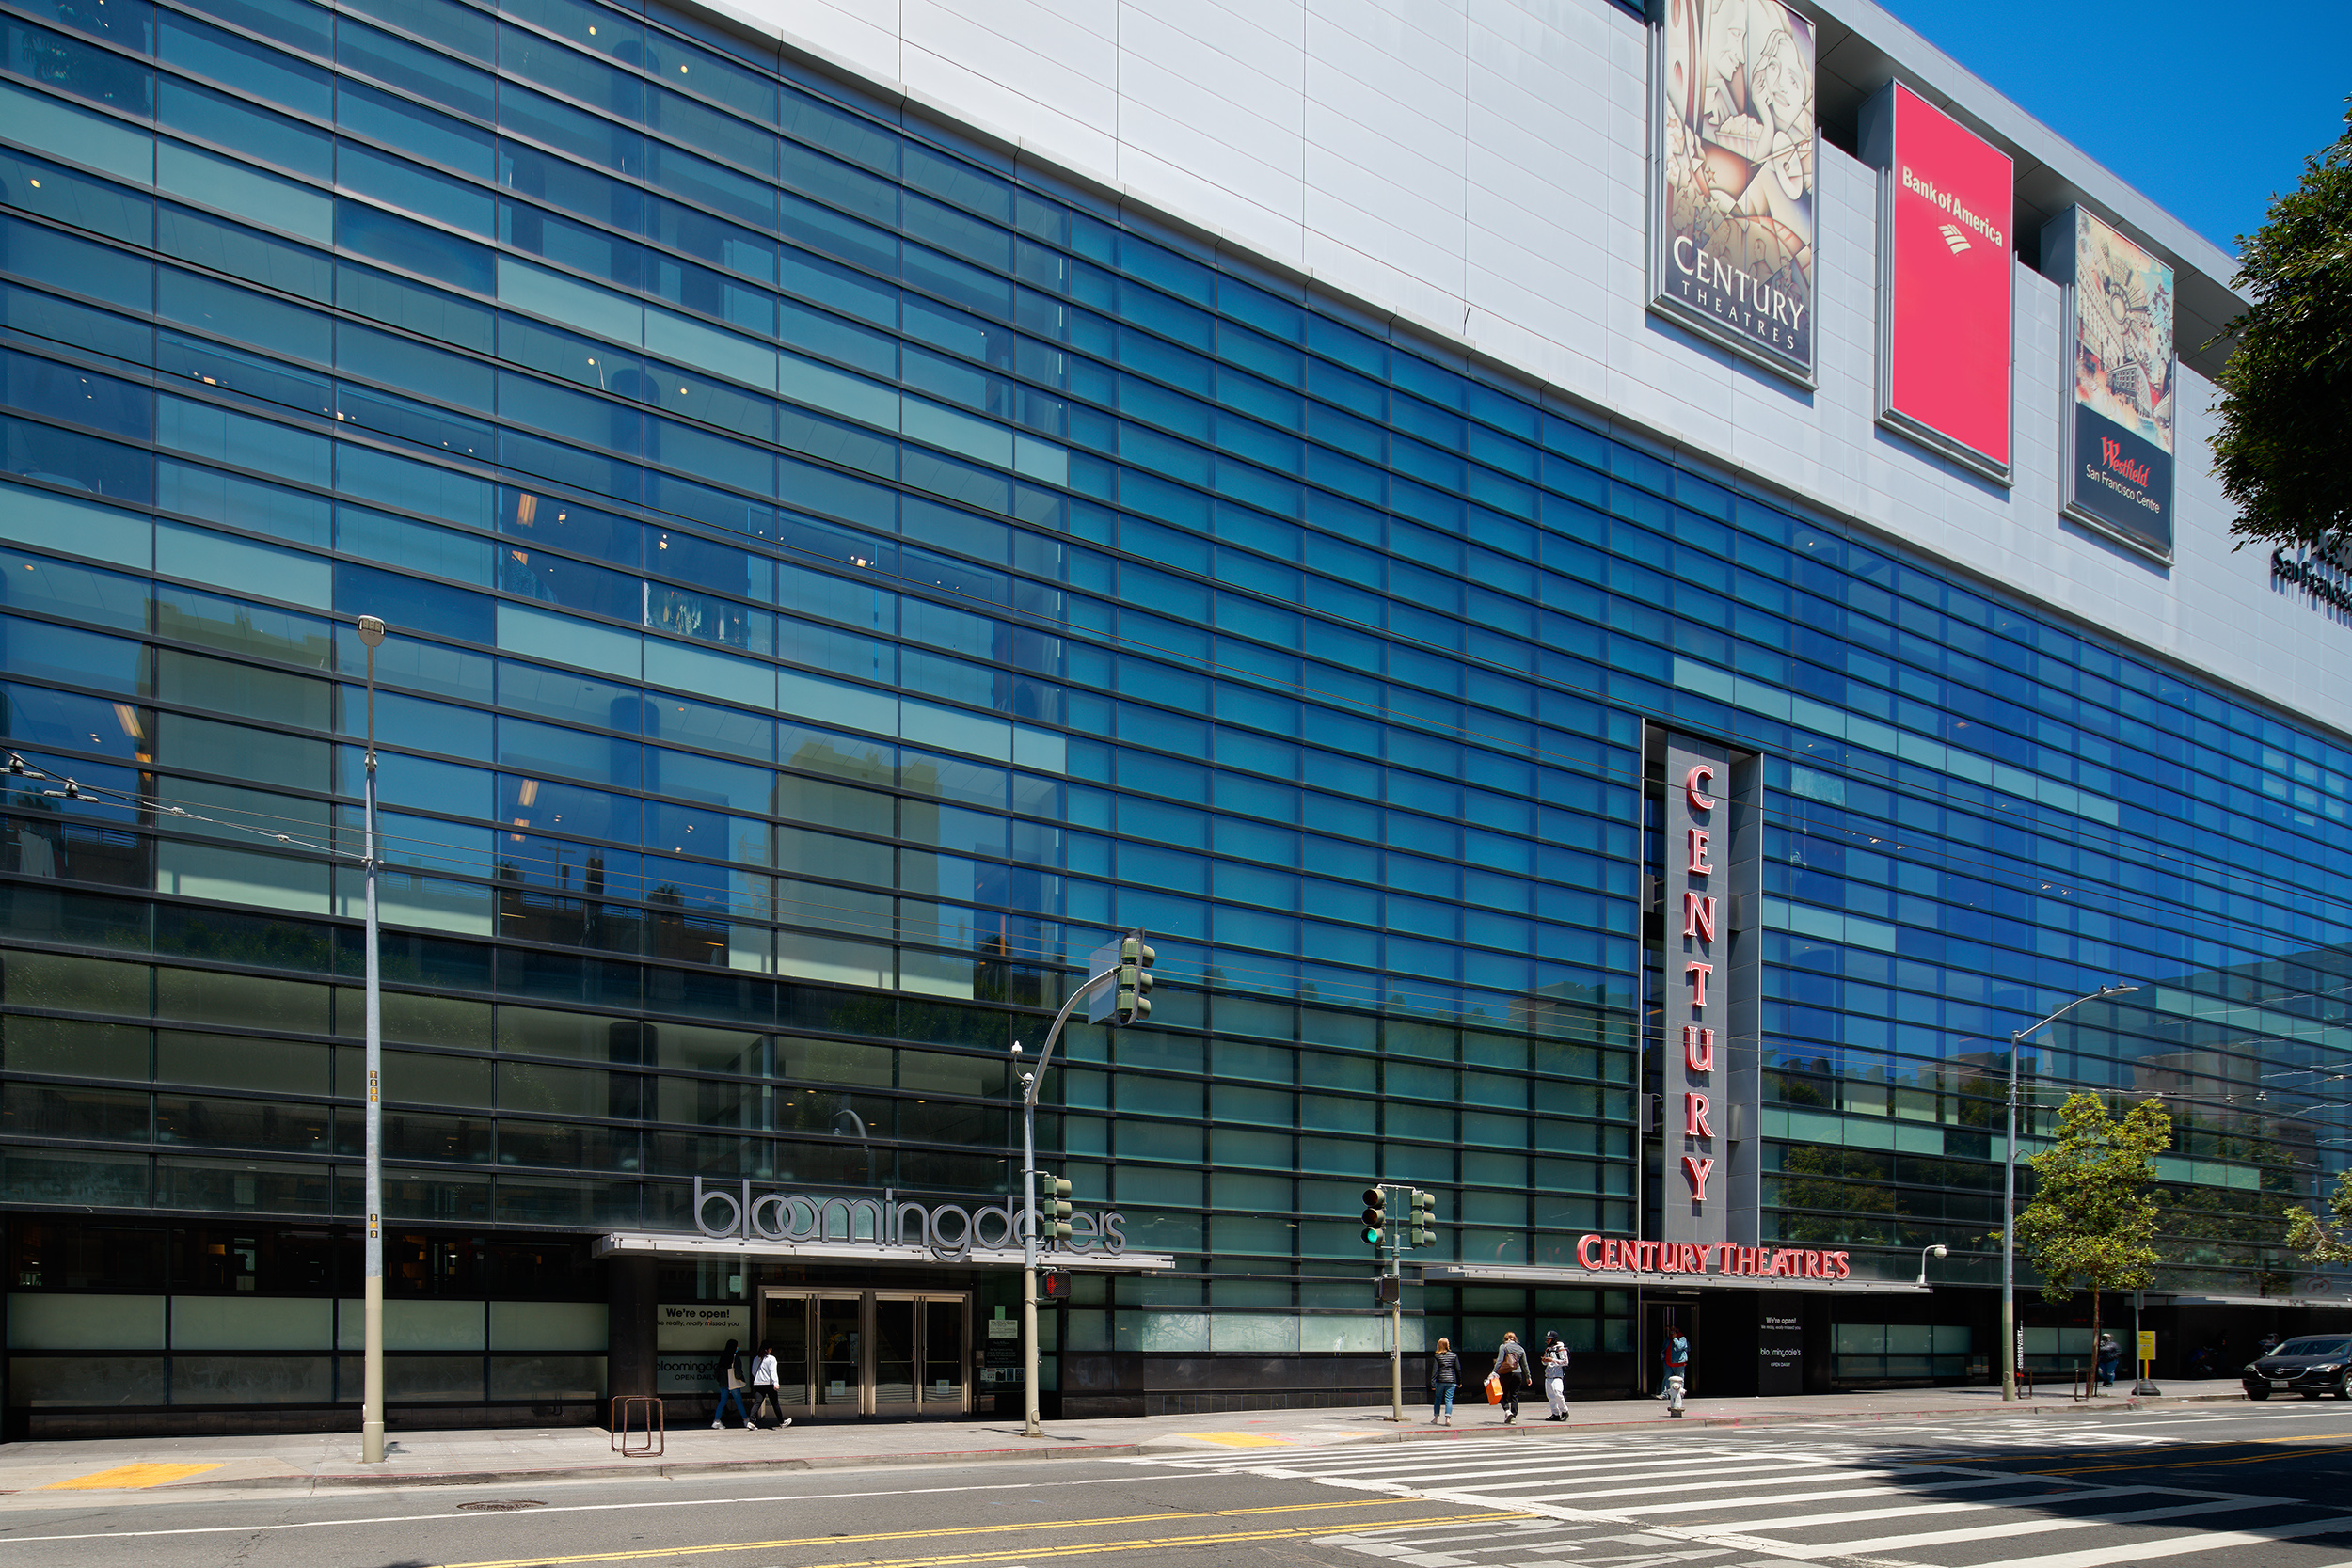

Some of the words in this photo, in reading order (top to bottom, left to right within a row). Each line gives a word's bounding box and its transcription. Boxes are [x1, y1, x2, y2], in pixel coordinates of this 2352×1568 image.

[1902, 165, 1937, 205] Bank
[1938, 192, 1952, 213] of
[1952, 198, 2003, 248] America
[1673, 235, 1804, 331] CENTURY
[1682, 280, 1794, 350] THEATRES
[2086, 464, 2100, 483] San
[2101, 471, 2136, 500] Francisco
[2136, 490, 2161, 514] Centre
[2100, 436, 2151, 488] Westfield
[1684, 764, 1717, 1201] CENTURY
[693, 1176, 1128, 1261] bloomingdae's
[1576, 1234, 1714, 1274] CENTURY
[1715, 1242, 1851, 1280] THEATRES
[666, 1308, 696, 1318] We're
[699, 1309, 730, 1320] open!
